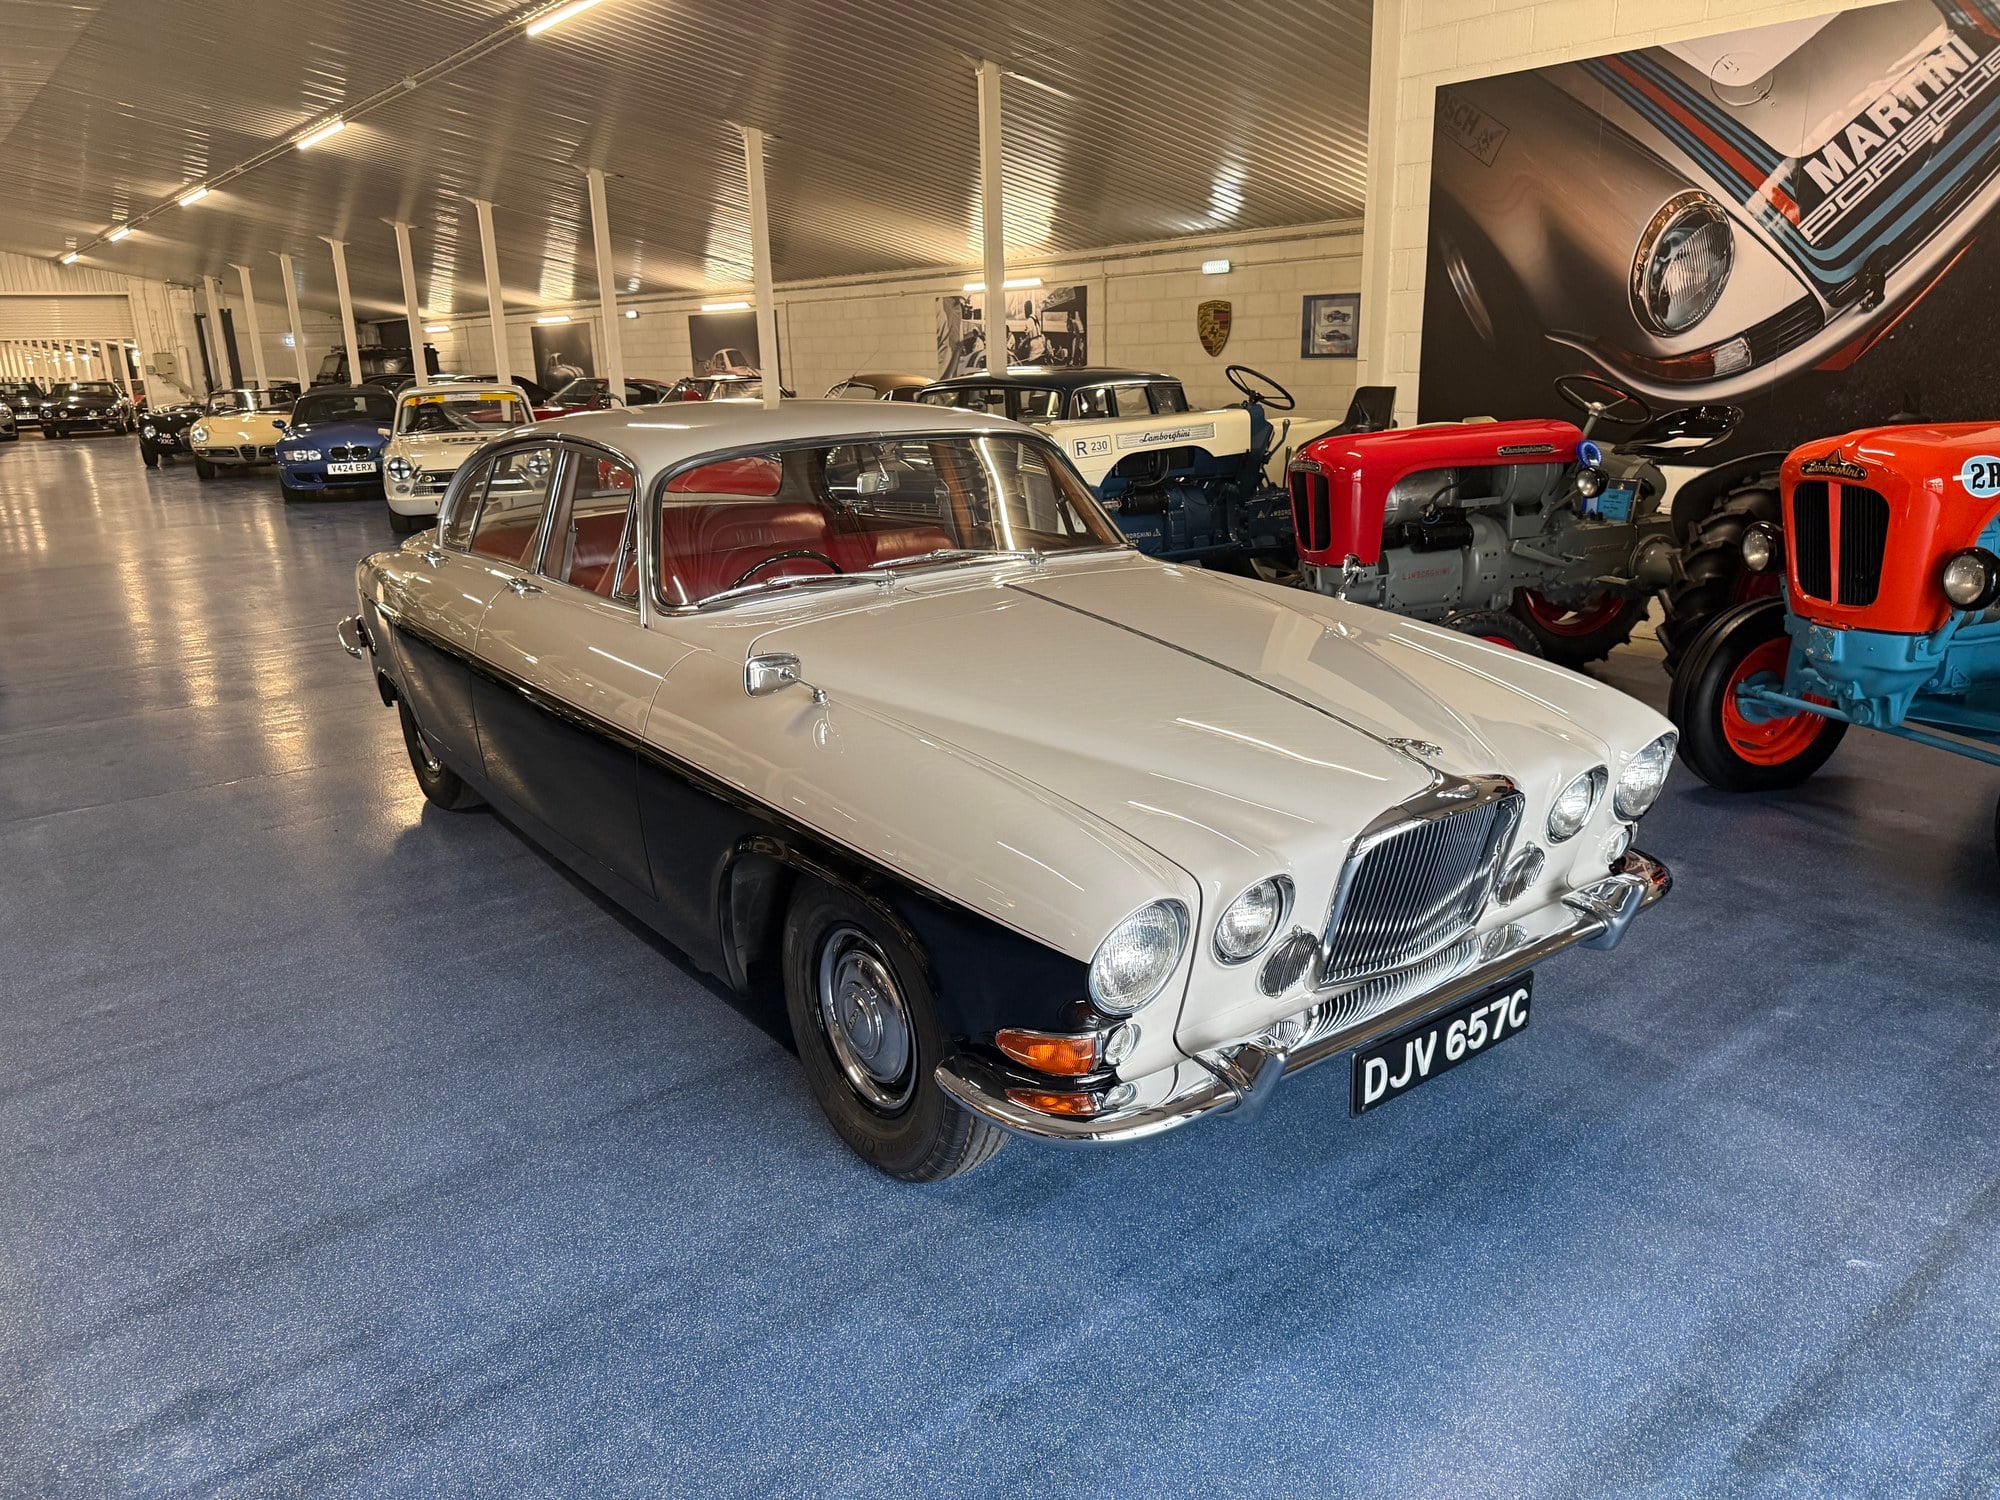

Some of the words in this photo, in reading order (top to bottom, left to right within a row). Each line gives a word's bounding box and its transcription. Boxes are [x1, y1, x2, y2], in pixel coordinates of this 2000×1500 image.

[1803, 34, 1980, 195] MARTINI
[1139, 428, 1191, 443] Lamborghini
[1076, 441, 1088, 456] R
[1091, 440, 1108, 451] 230
[331, 464, 354, 473] V424
[356, 463, 373, 472] ERX
[1806, 461, 1860, 479] Lamborghini
[1364, 1030, 1438, 1105] DJV
[1445, 988, 1529, 1061] 657C
